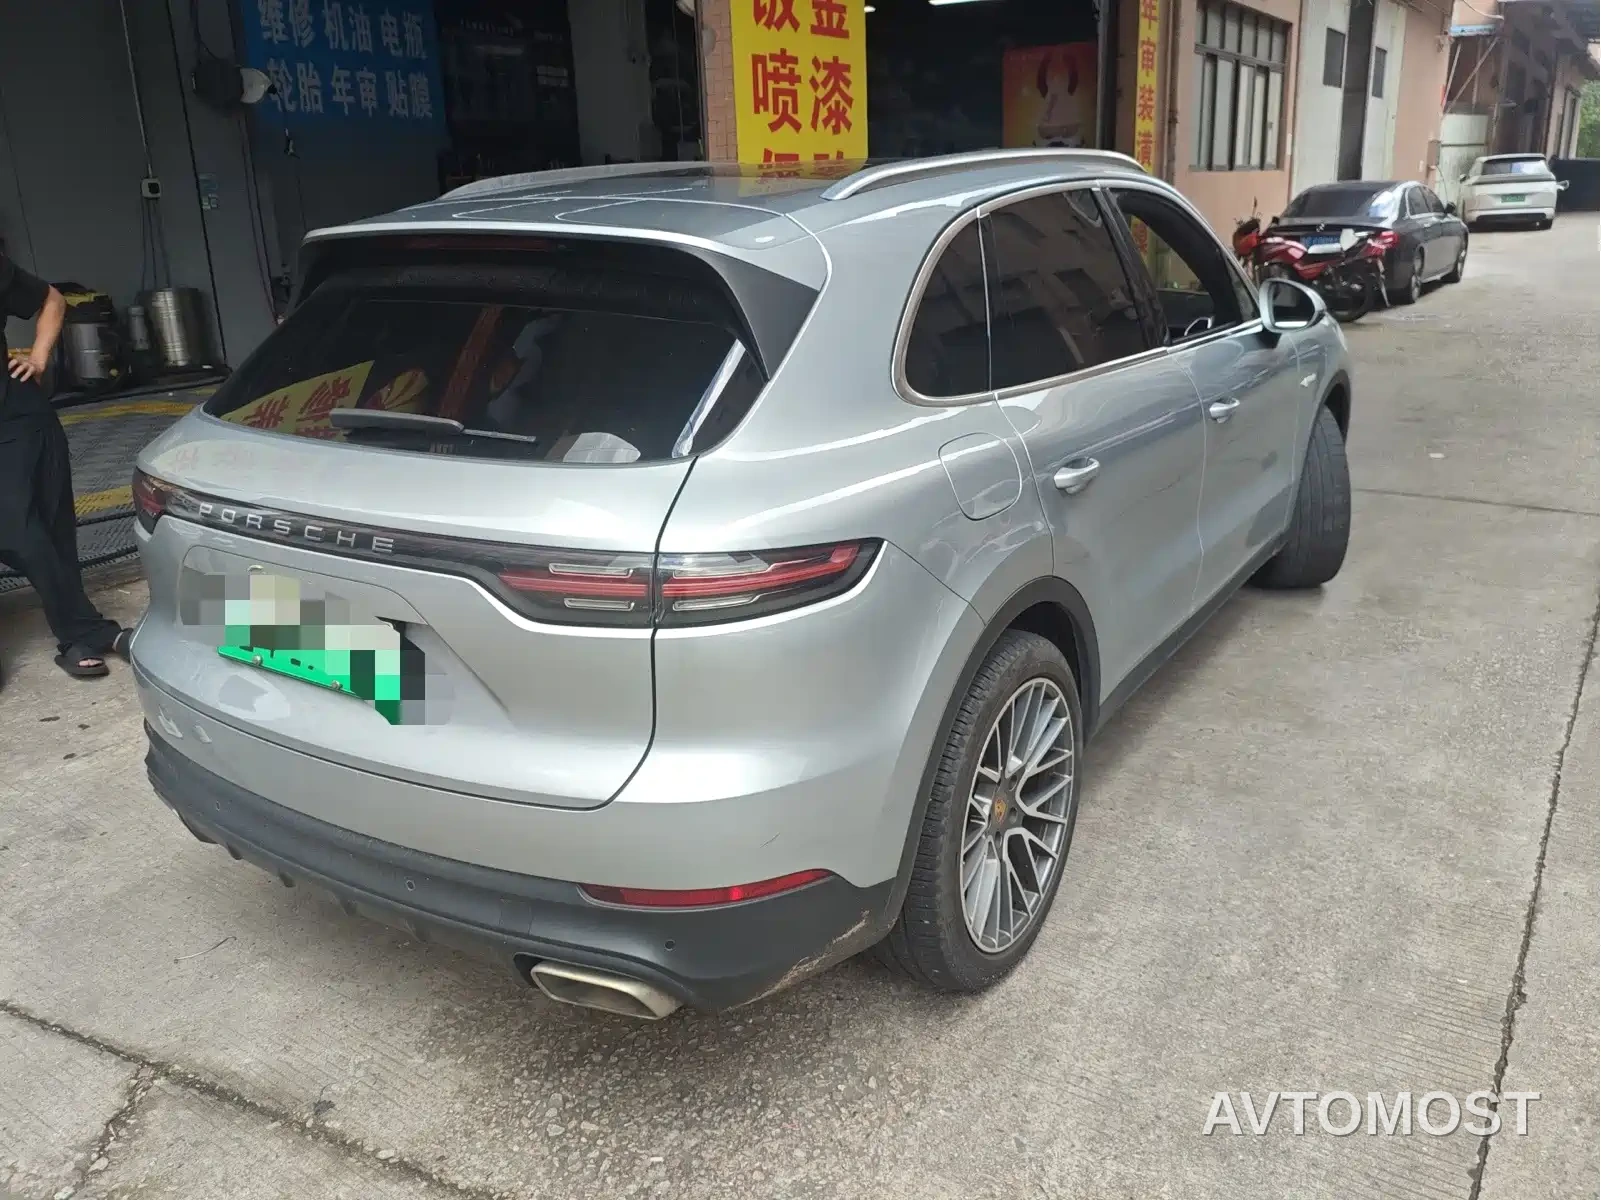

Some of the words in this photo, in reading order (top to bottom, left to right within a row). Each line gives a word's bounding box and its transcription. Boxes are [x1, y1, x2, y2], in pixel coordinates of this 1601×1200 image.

[257, 0, 316, 48] 维修
[323, 0, 373, 54] 机油
[379, 7, 429, 60] 电瓶
[266, 57, 324, 114] 轮胎
[331, 62, 379, 118] 年审
[385, 69, 433, 119] 贴膜
[751, 48, 854, 135] 喷漆
[199, 503, 395, 552] PORSCHE
